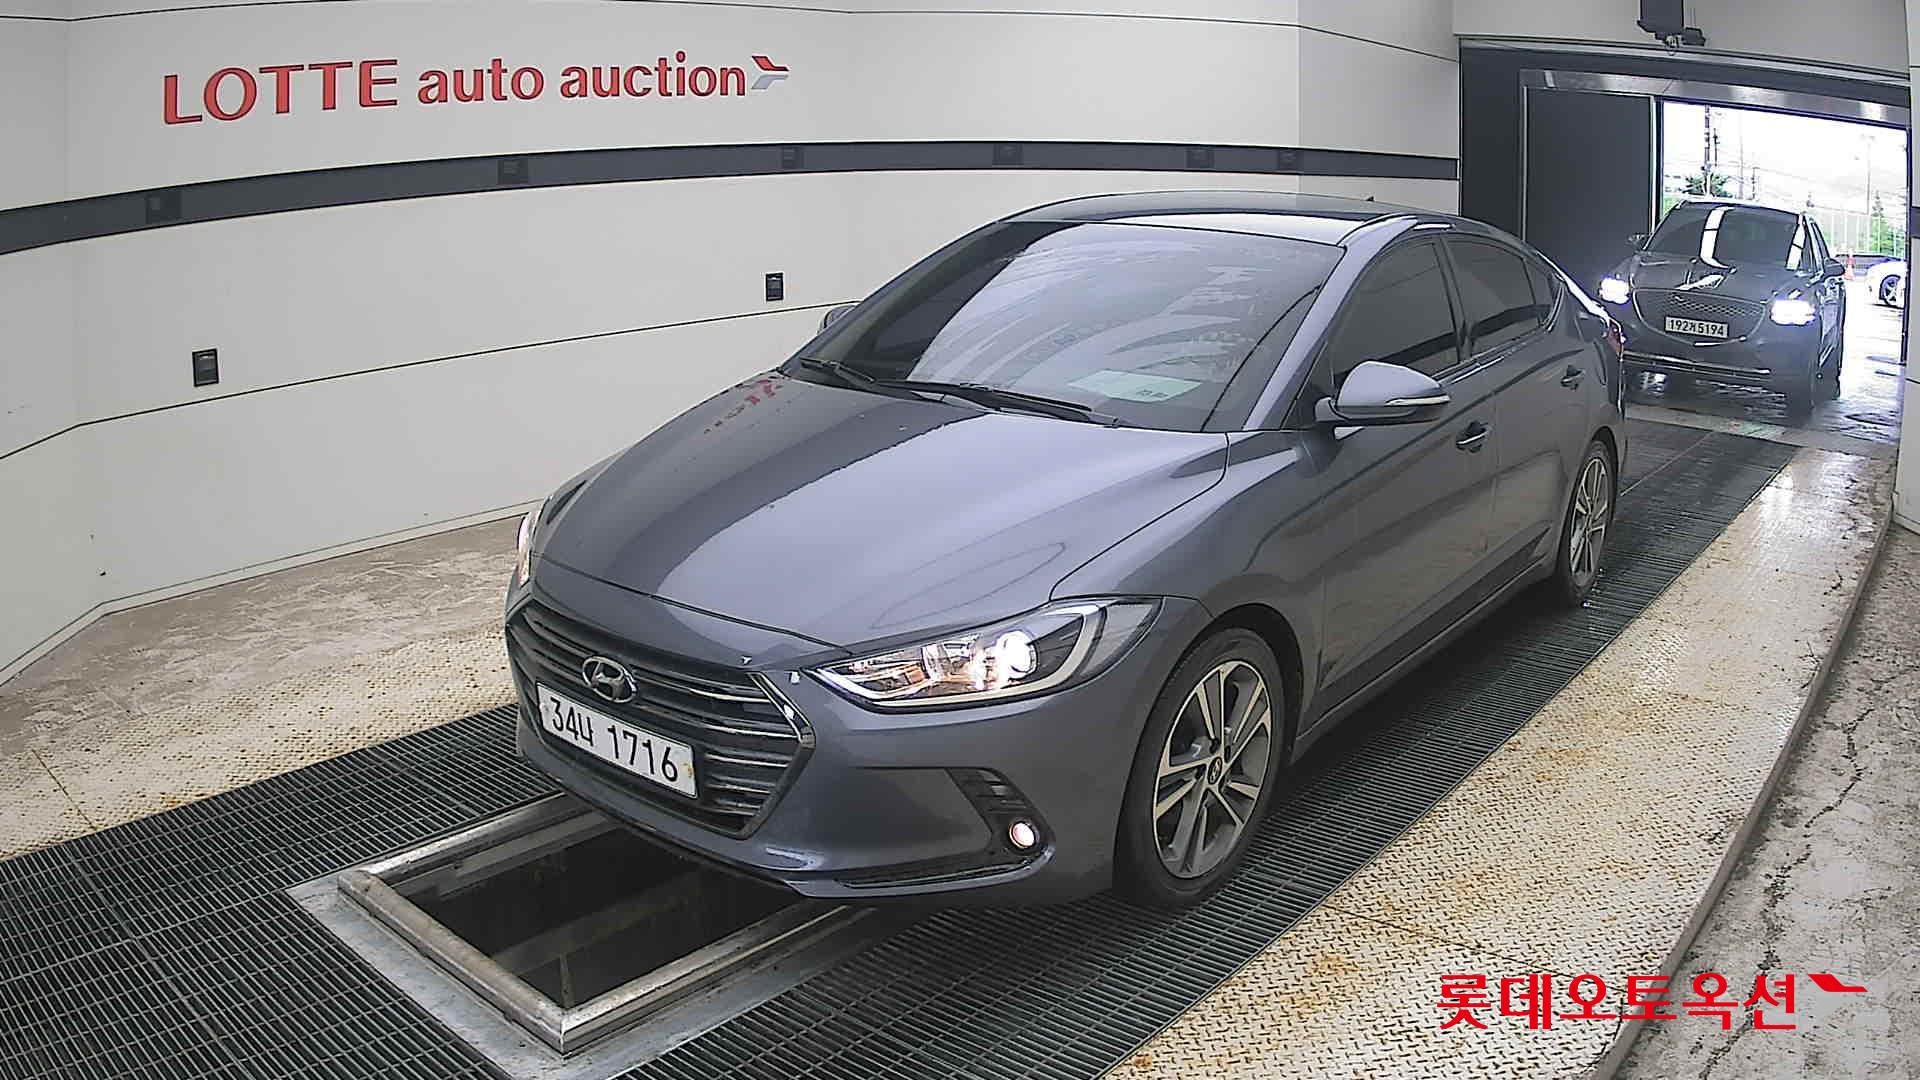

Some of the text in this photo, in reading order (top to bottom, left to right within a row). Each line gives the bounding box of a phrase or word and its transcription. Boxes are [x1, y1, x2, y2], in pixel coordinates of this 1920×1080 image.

[163, 50, 748, 126] LOTTE auto auction
[607, 724, 679, 782] 1716
